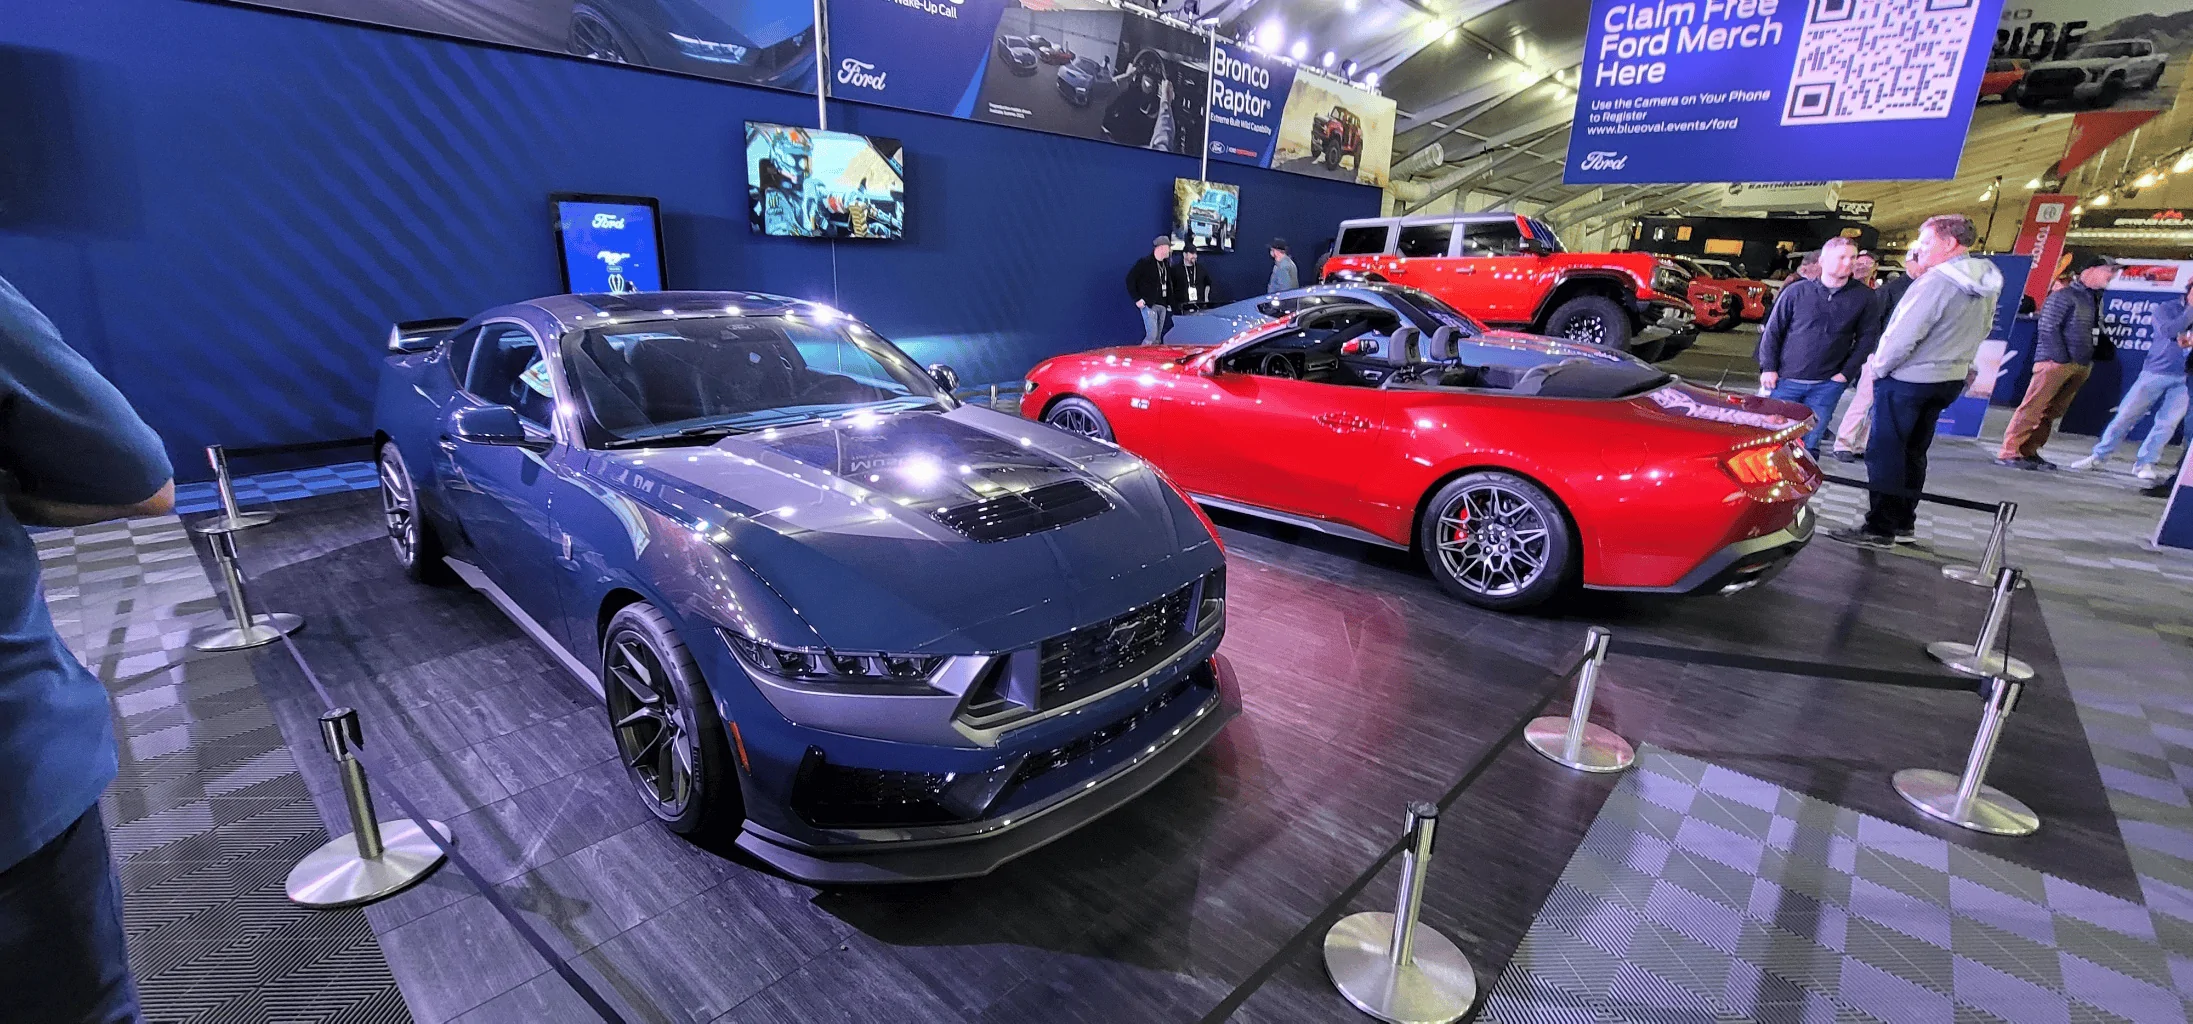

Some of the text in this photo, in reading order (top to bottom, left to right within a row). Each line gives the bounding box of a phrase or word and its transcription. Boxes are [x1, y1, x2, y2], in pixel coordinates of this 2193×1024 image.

[938, 3, 958, 19] Call
[1604, 0, 1780, 33] Claim Free
[1600, 16, 1784, 60] Ford Merch
[837, 58, 887, 90] Ford
[1213, 46, 1270, 90] Bronco
[1595, 61, 1667, 87] Here
[1591, 90, 1771, 111] Use the Camera on Your Phone
[1210, 112, 1272, 136] Extreme Built Wild Capability
[1587, 117, 1738, 135] www.blueoval.events/ford
[1589, 110, 1648, 124] to Register
[1581, 150, 1628, 171] Ford
[592, 213, 625, 229] Ford
[2109, 299, 2158, 313] Regis
[2104, 312, 2152, 325] a cha
[2136, 327, 2148, 338] a
